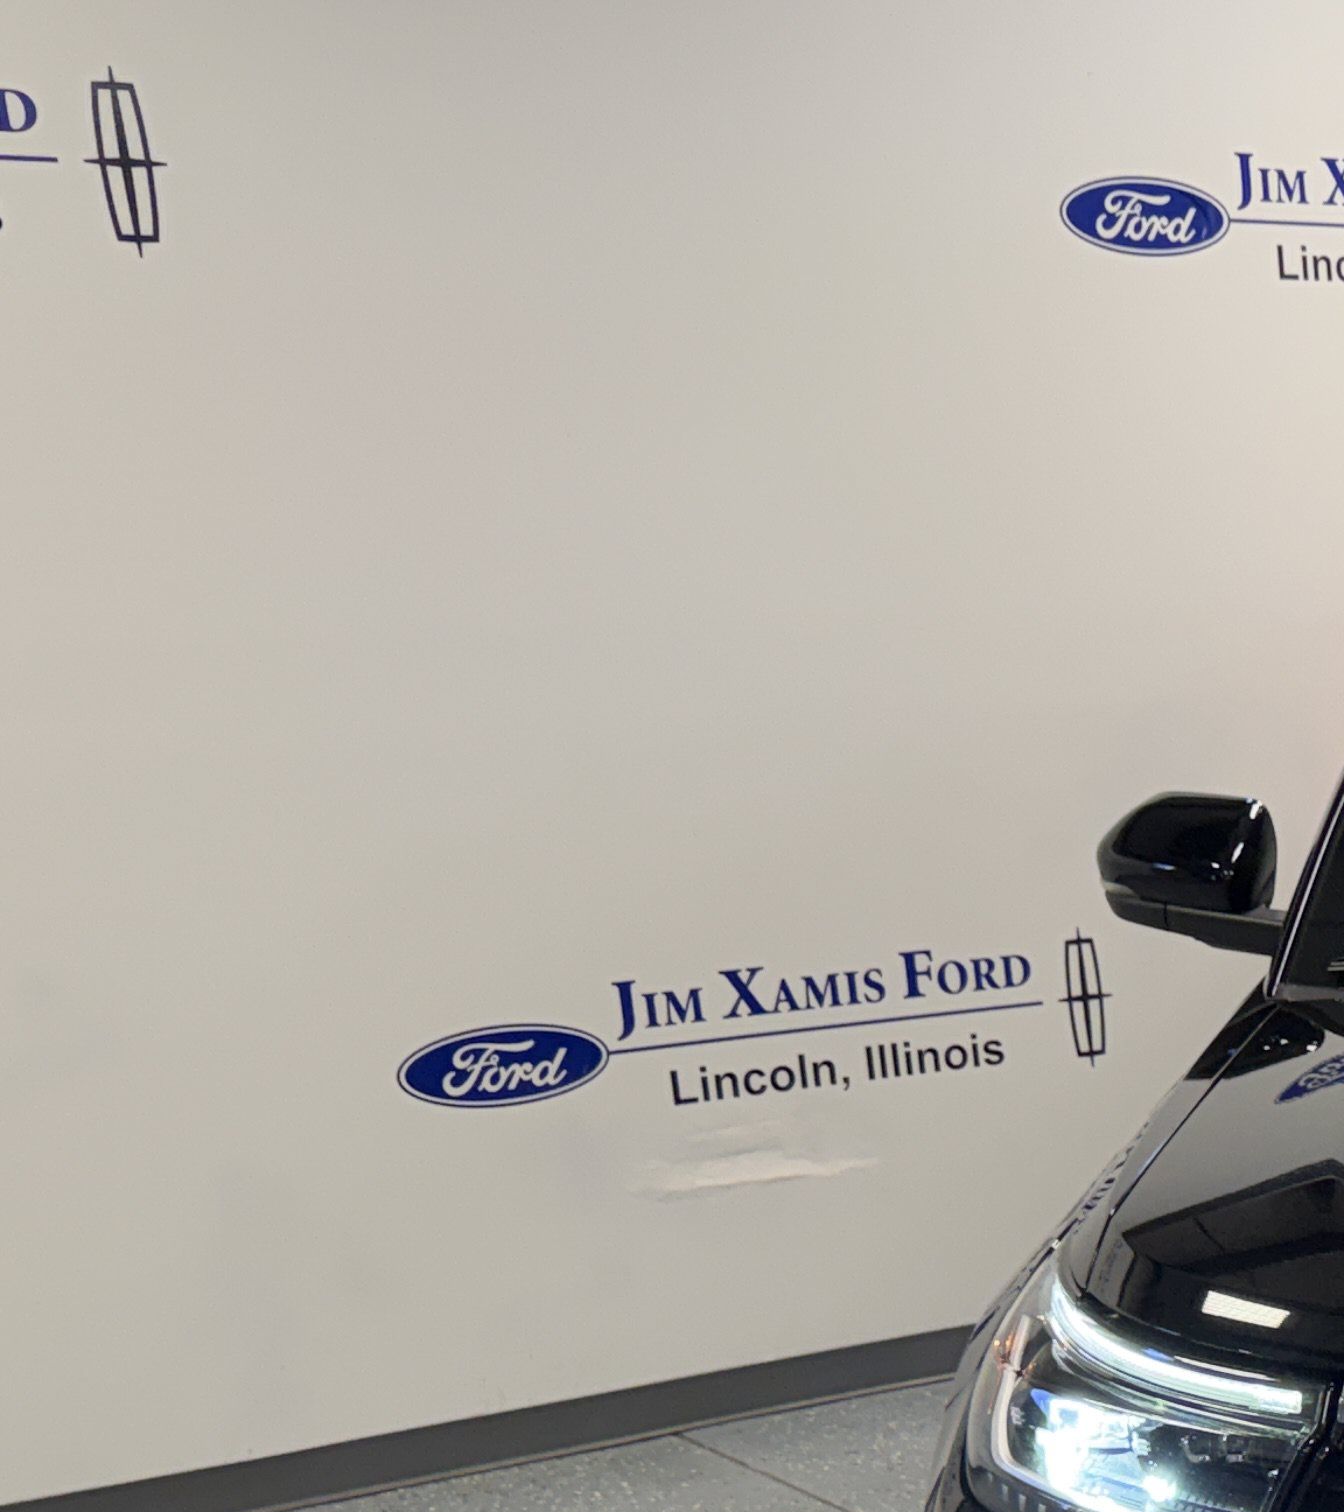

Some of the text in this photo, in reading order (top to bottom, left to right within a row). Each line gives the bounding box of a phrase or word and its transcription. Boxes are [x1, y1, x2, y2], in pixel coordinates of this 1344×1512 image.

[1235, 152, 1308, 210] JIM
[1095, 189, 1197, 244] Ford
[612, 950, 1030, 1041] JIM XAMIS FORD
[442, 1038, 568, 1098] Ford
[670, 1034, 1004, 1105] Lincoln, Illinois
